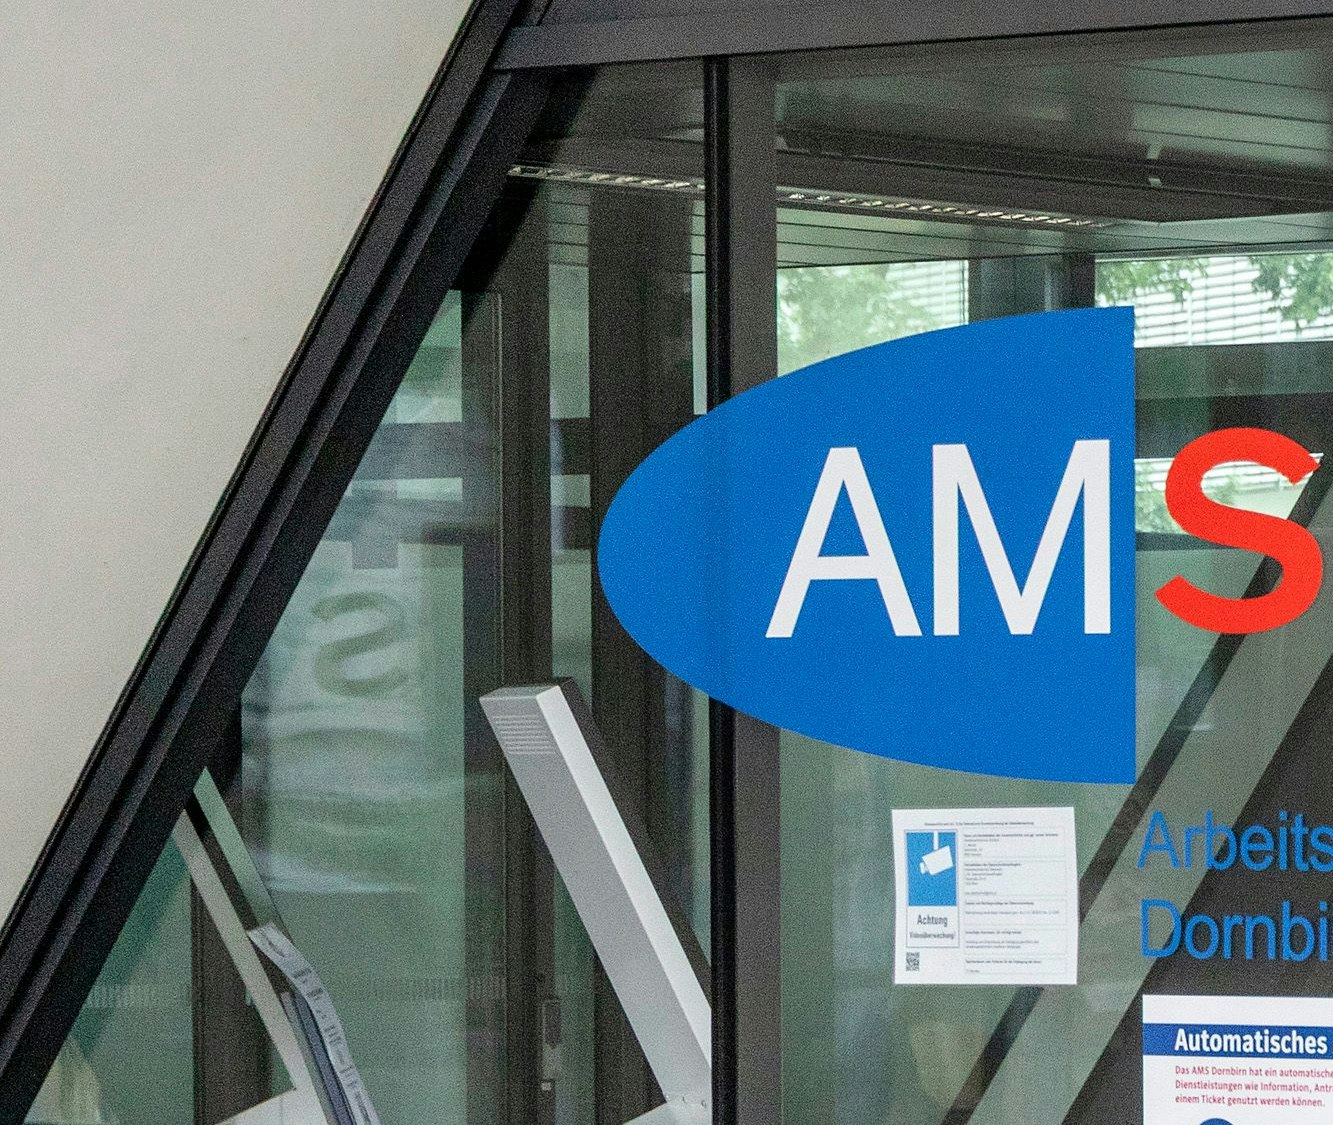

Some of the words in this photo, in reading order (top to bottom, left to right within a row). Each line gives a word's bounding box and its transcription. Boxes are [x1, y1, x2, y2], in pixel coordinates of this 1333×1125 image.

[766, 428, 1324, 638] AMS
[917, 915, 947, 927] Achtung
[1175, 1028, 1327, 1055] Automatisches
[1175, 1065, 1189, 1074] Das
[1192, 1066, 1209, 1074] AMS
[1211, 1066, 1246, 1075] Dornbirn
[1249, 1067, 1262, 1076] hat
[1175, 1079, 1242, 1092] Dienstleistungen
[1261, 1082, 1311, 1093] Information,
[1201, 1094, 1224, 1103] Ticket
[1227, 1097, 1257, 1106] genutzt
[1292, 1097, 1324, 1106] können.
